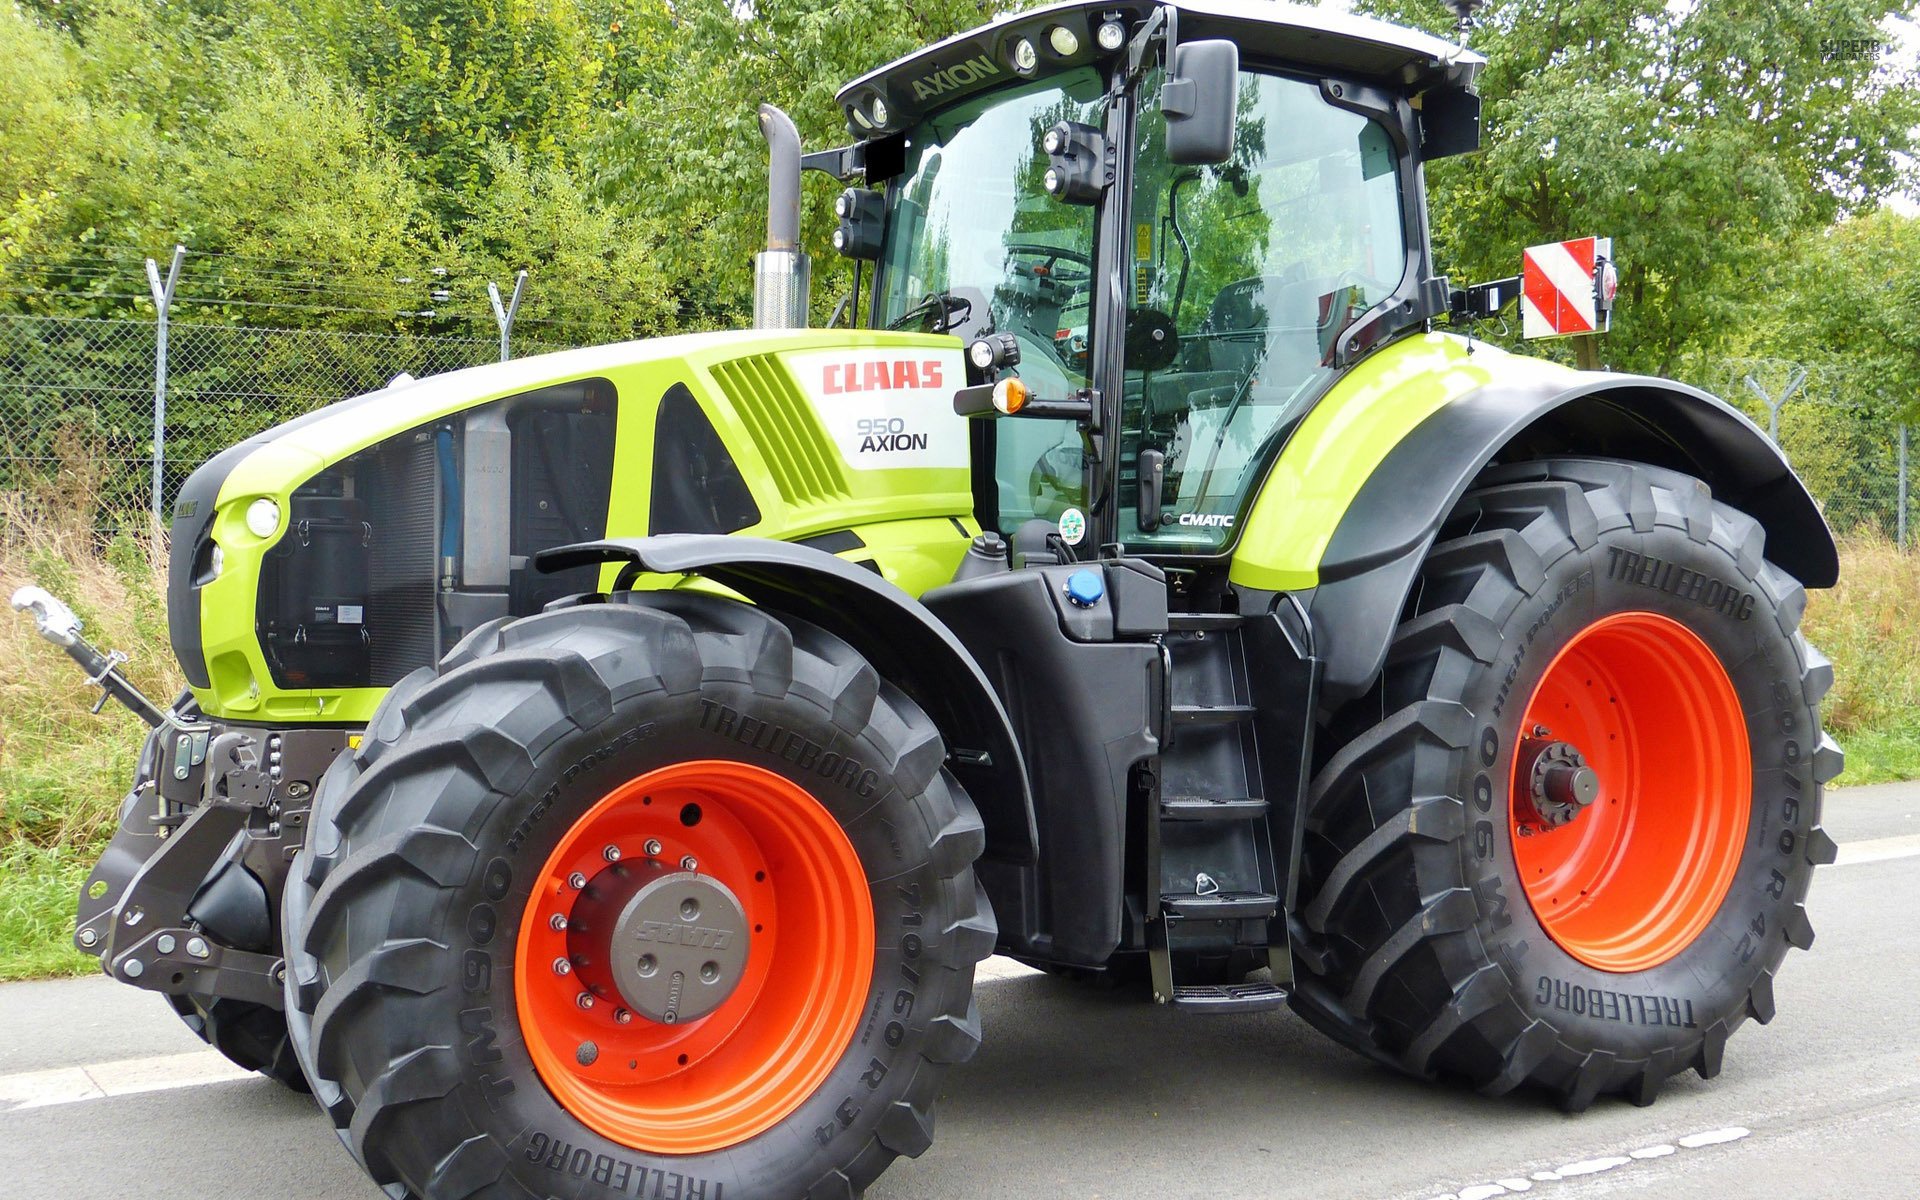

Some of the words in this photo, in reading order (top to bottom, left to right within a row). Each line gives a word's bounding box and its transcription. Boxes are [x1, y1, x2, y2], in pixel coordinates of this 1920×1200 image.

[912, 55, 999, 100] AXION
[823, 361, 942, 394] CLAAS
[857, 418, 904, 435] 950
[860, 433, 927, 452] AXION
[1179, 513, 1235, 527] CMATIC
[1608, 545, 1756, 622] TRELLEBORG
[562, 722, 656, 785] POWER
[700, 698, 880, 797] TRELLEBORG
[1766, 868, 1787, 901] R
[634, 920, 734, 950] CLAAS
[884, 883, 923, 1048] 710/60
[1535, 975, 1698, 1029] TRELLEBORG
[860, 1056, 889, 1090] R
[814, 1096, 861, 1146] 34
